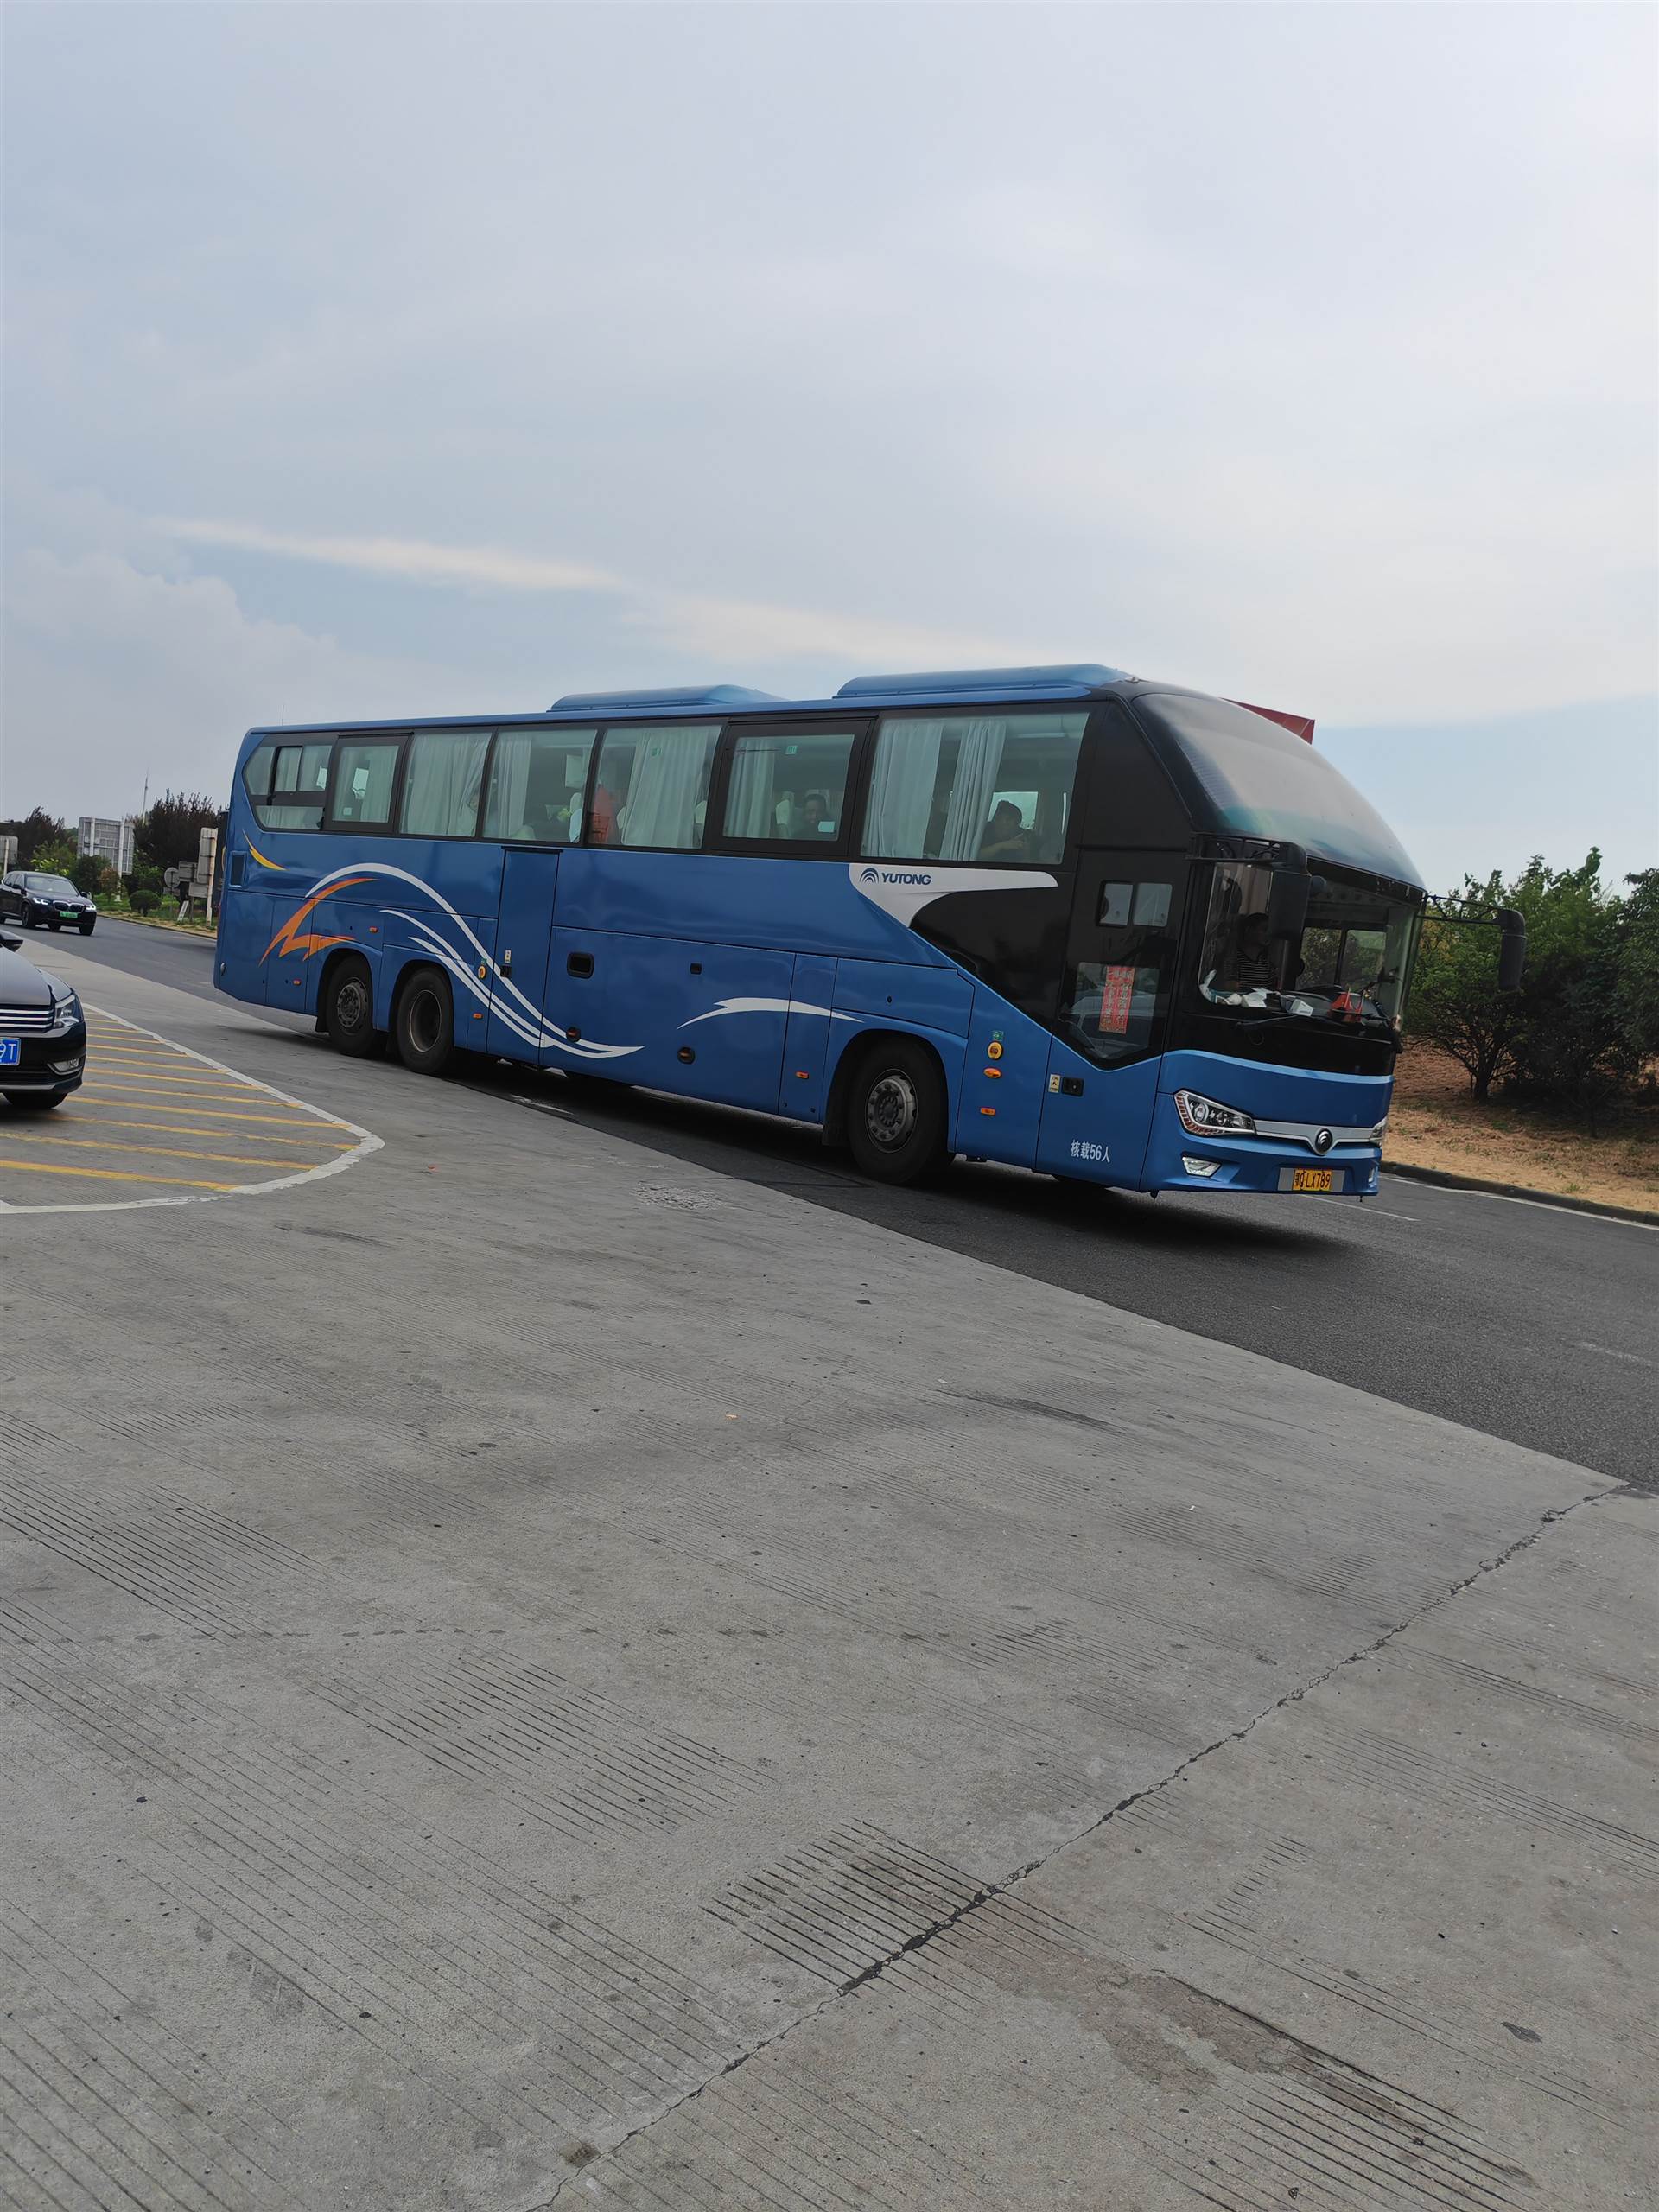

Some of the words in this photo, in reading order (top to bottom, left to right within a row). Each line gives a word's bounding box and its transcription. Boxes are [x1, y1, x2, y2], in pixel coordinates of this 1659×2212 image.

[881, 873, 931, 885] YUTONG
[1071, 1140, 1110, 1163] 核载56人
